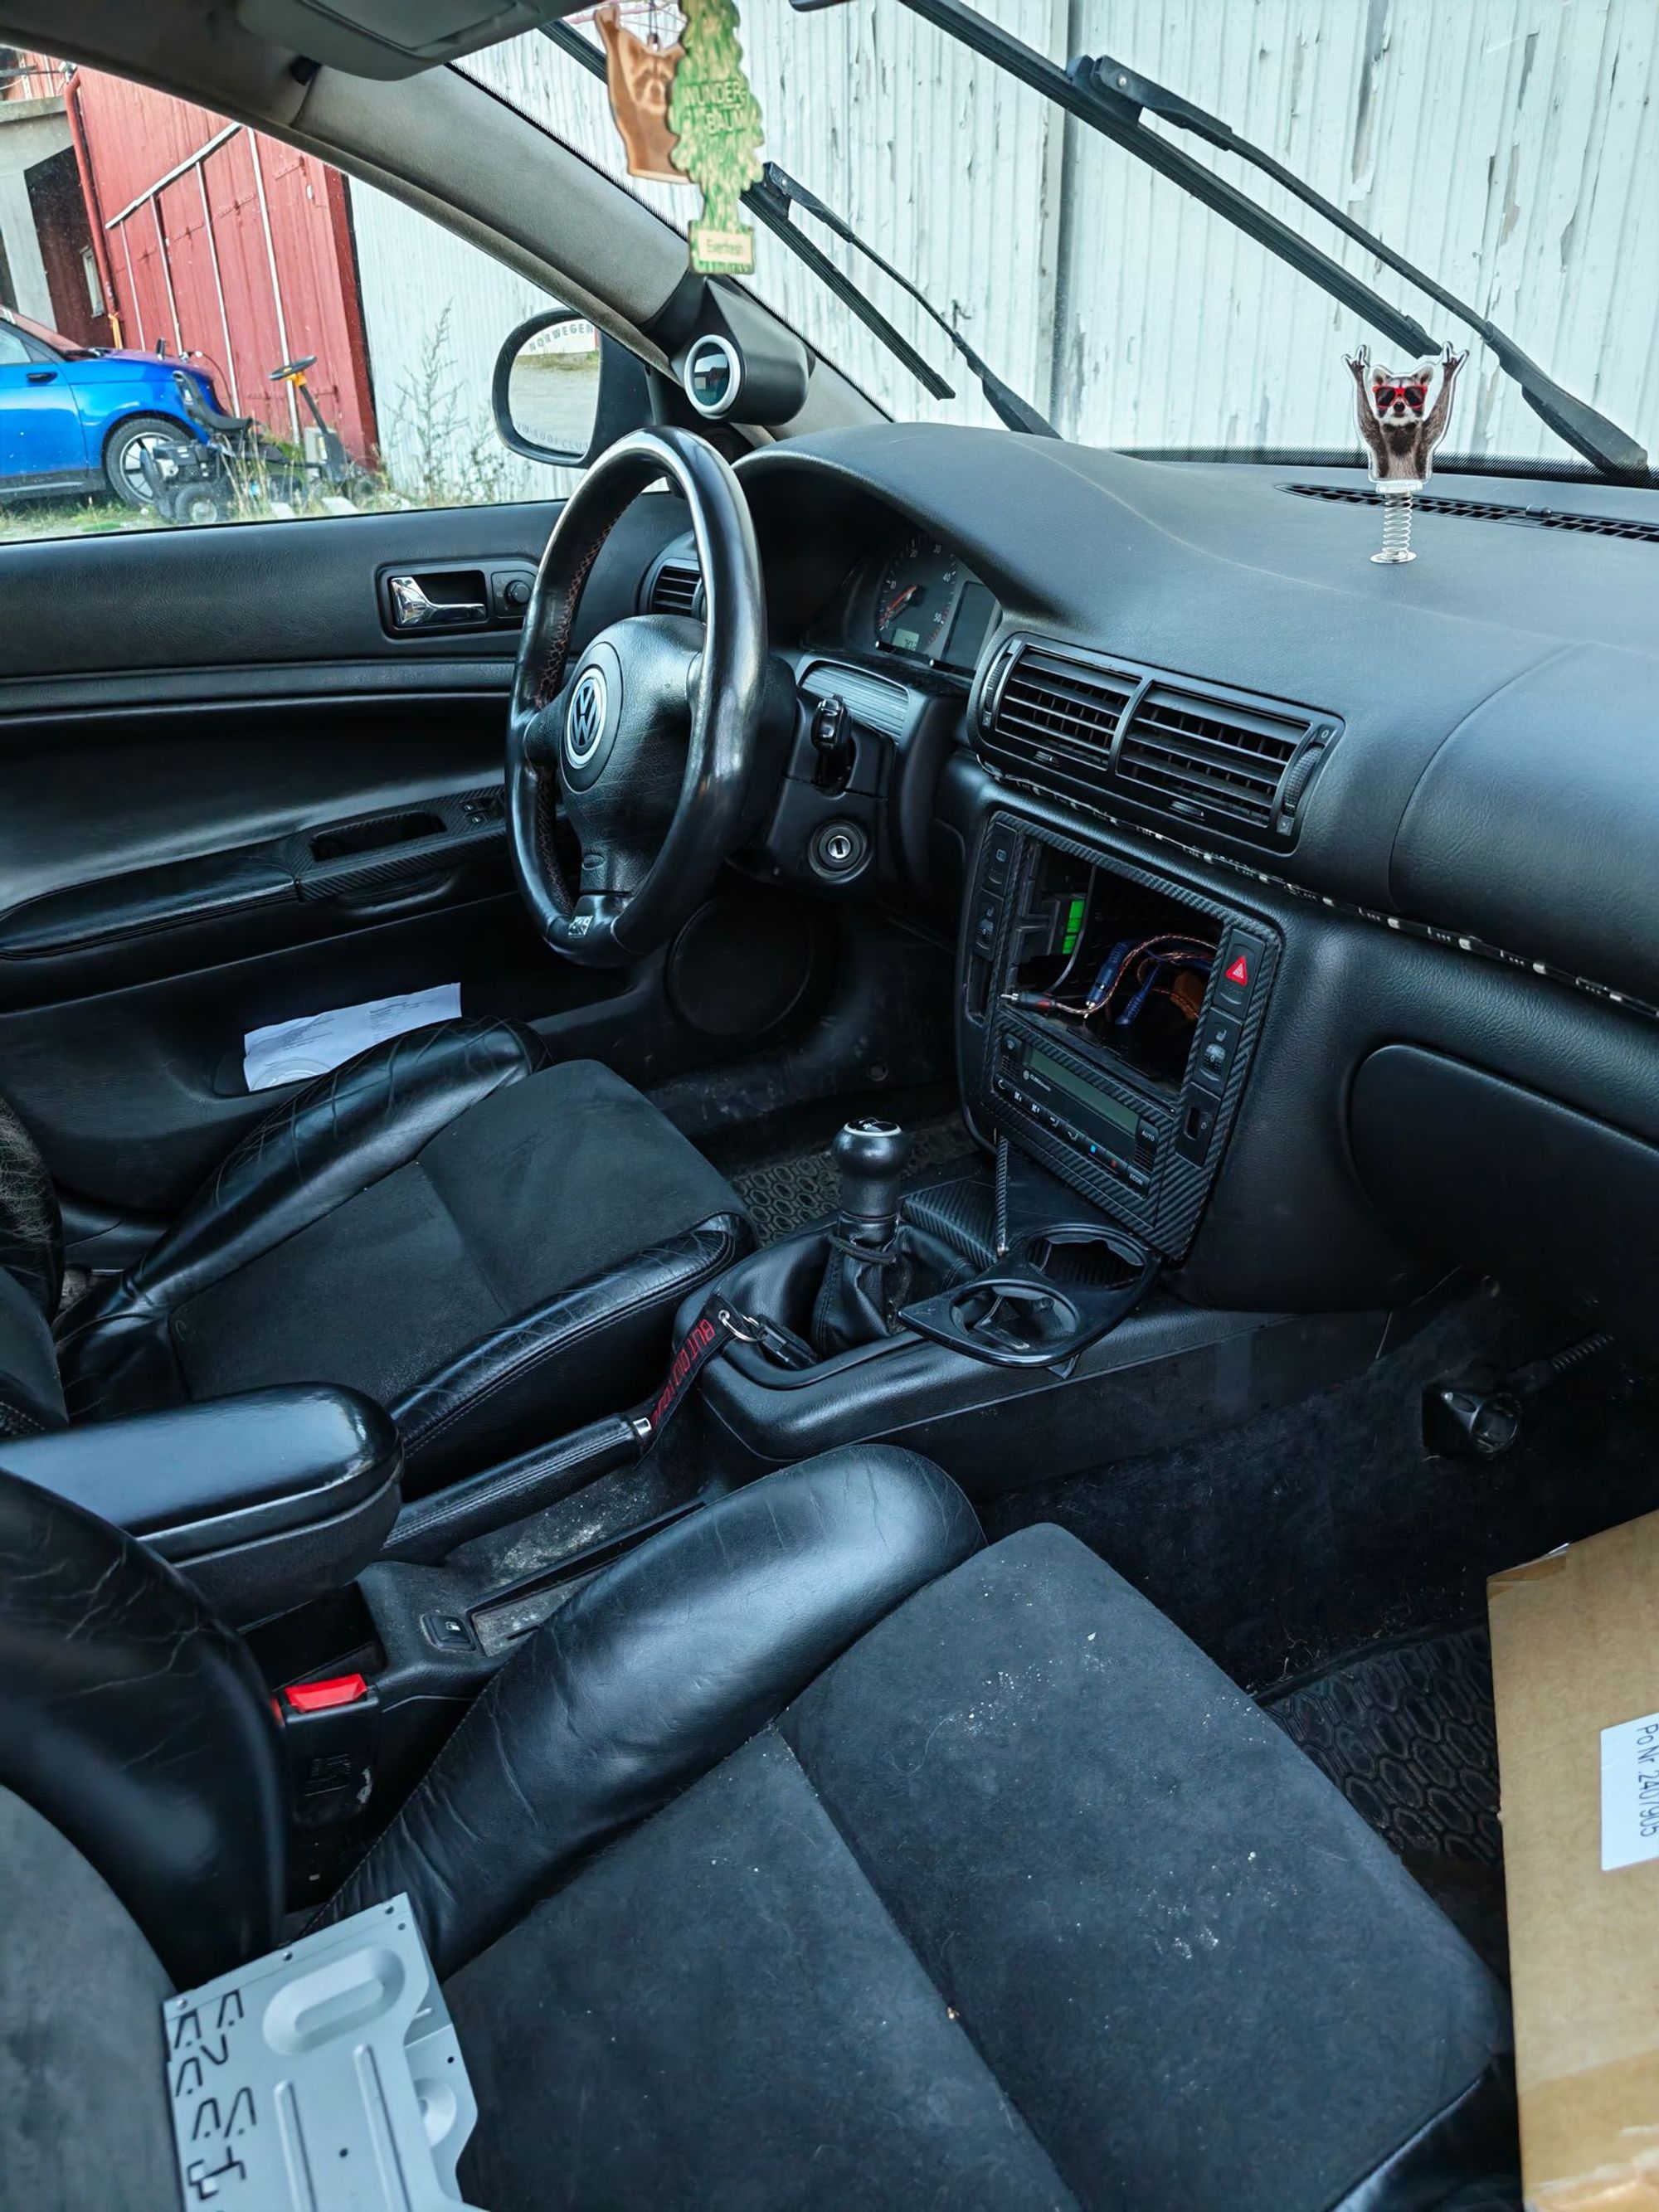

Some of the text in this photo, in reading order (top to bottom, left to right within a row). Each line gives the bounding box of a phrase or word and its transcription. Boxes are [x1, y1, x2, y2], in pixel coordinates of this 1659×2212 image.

[708, 108, 745, 134] BAUM
[528, 323, 594, 352] NORWEGEN
[1141, 1130, 1155, 1141] AUTO
[1637, 1745, 1659, 1764] Nr
